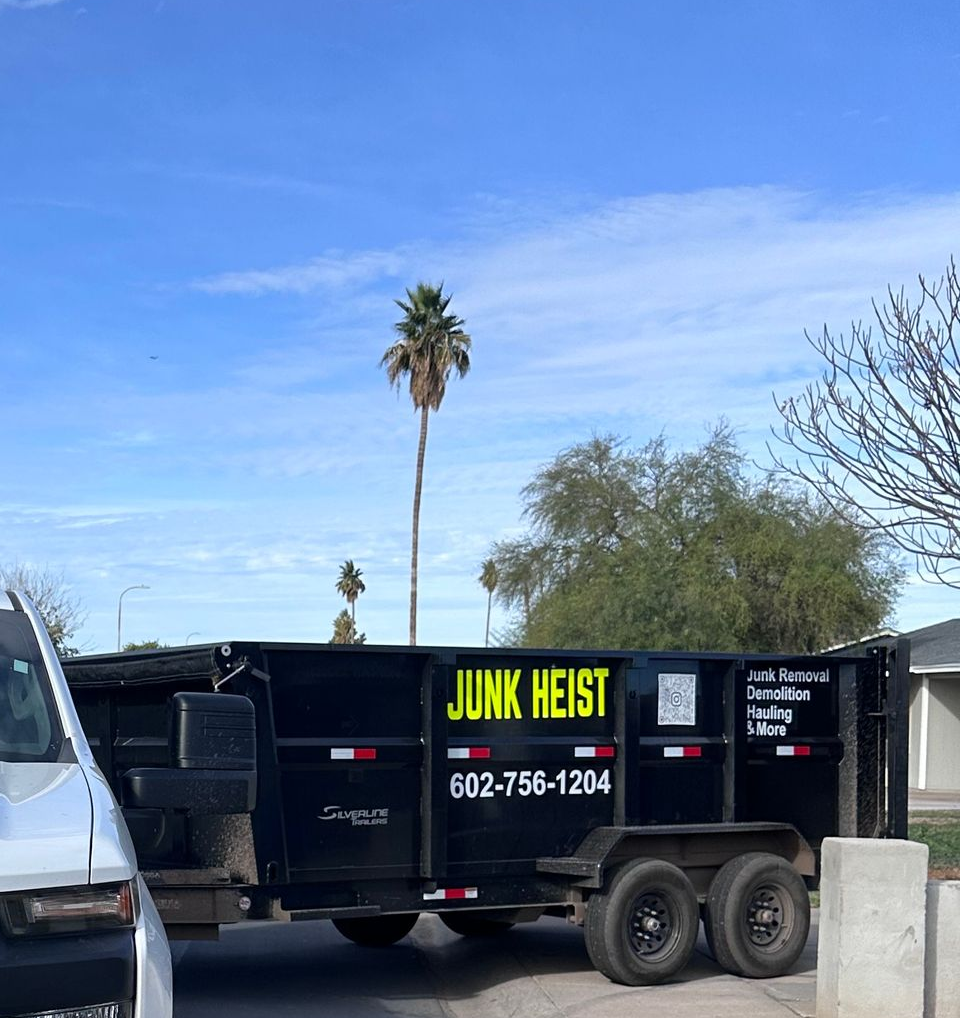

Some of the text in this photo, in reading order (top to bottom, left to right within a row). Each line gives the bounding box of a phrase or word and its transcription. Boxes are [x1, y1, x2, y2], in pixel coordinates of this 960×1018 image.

[747, 667, 830, 683] Junk Removal
[447, 667, 610, 720] JUNK HEIST
[747, 685, 811, 701] Demolition
[747, 704, 792, 724] Hauling
[449, 769, 612, 799] 602-756-1204
[317, 805, 389, 820] SILVERLINE
[352, 818, 388, 826] TRAILERS
